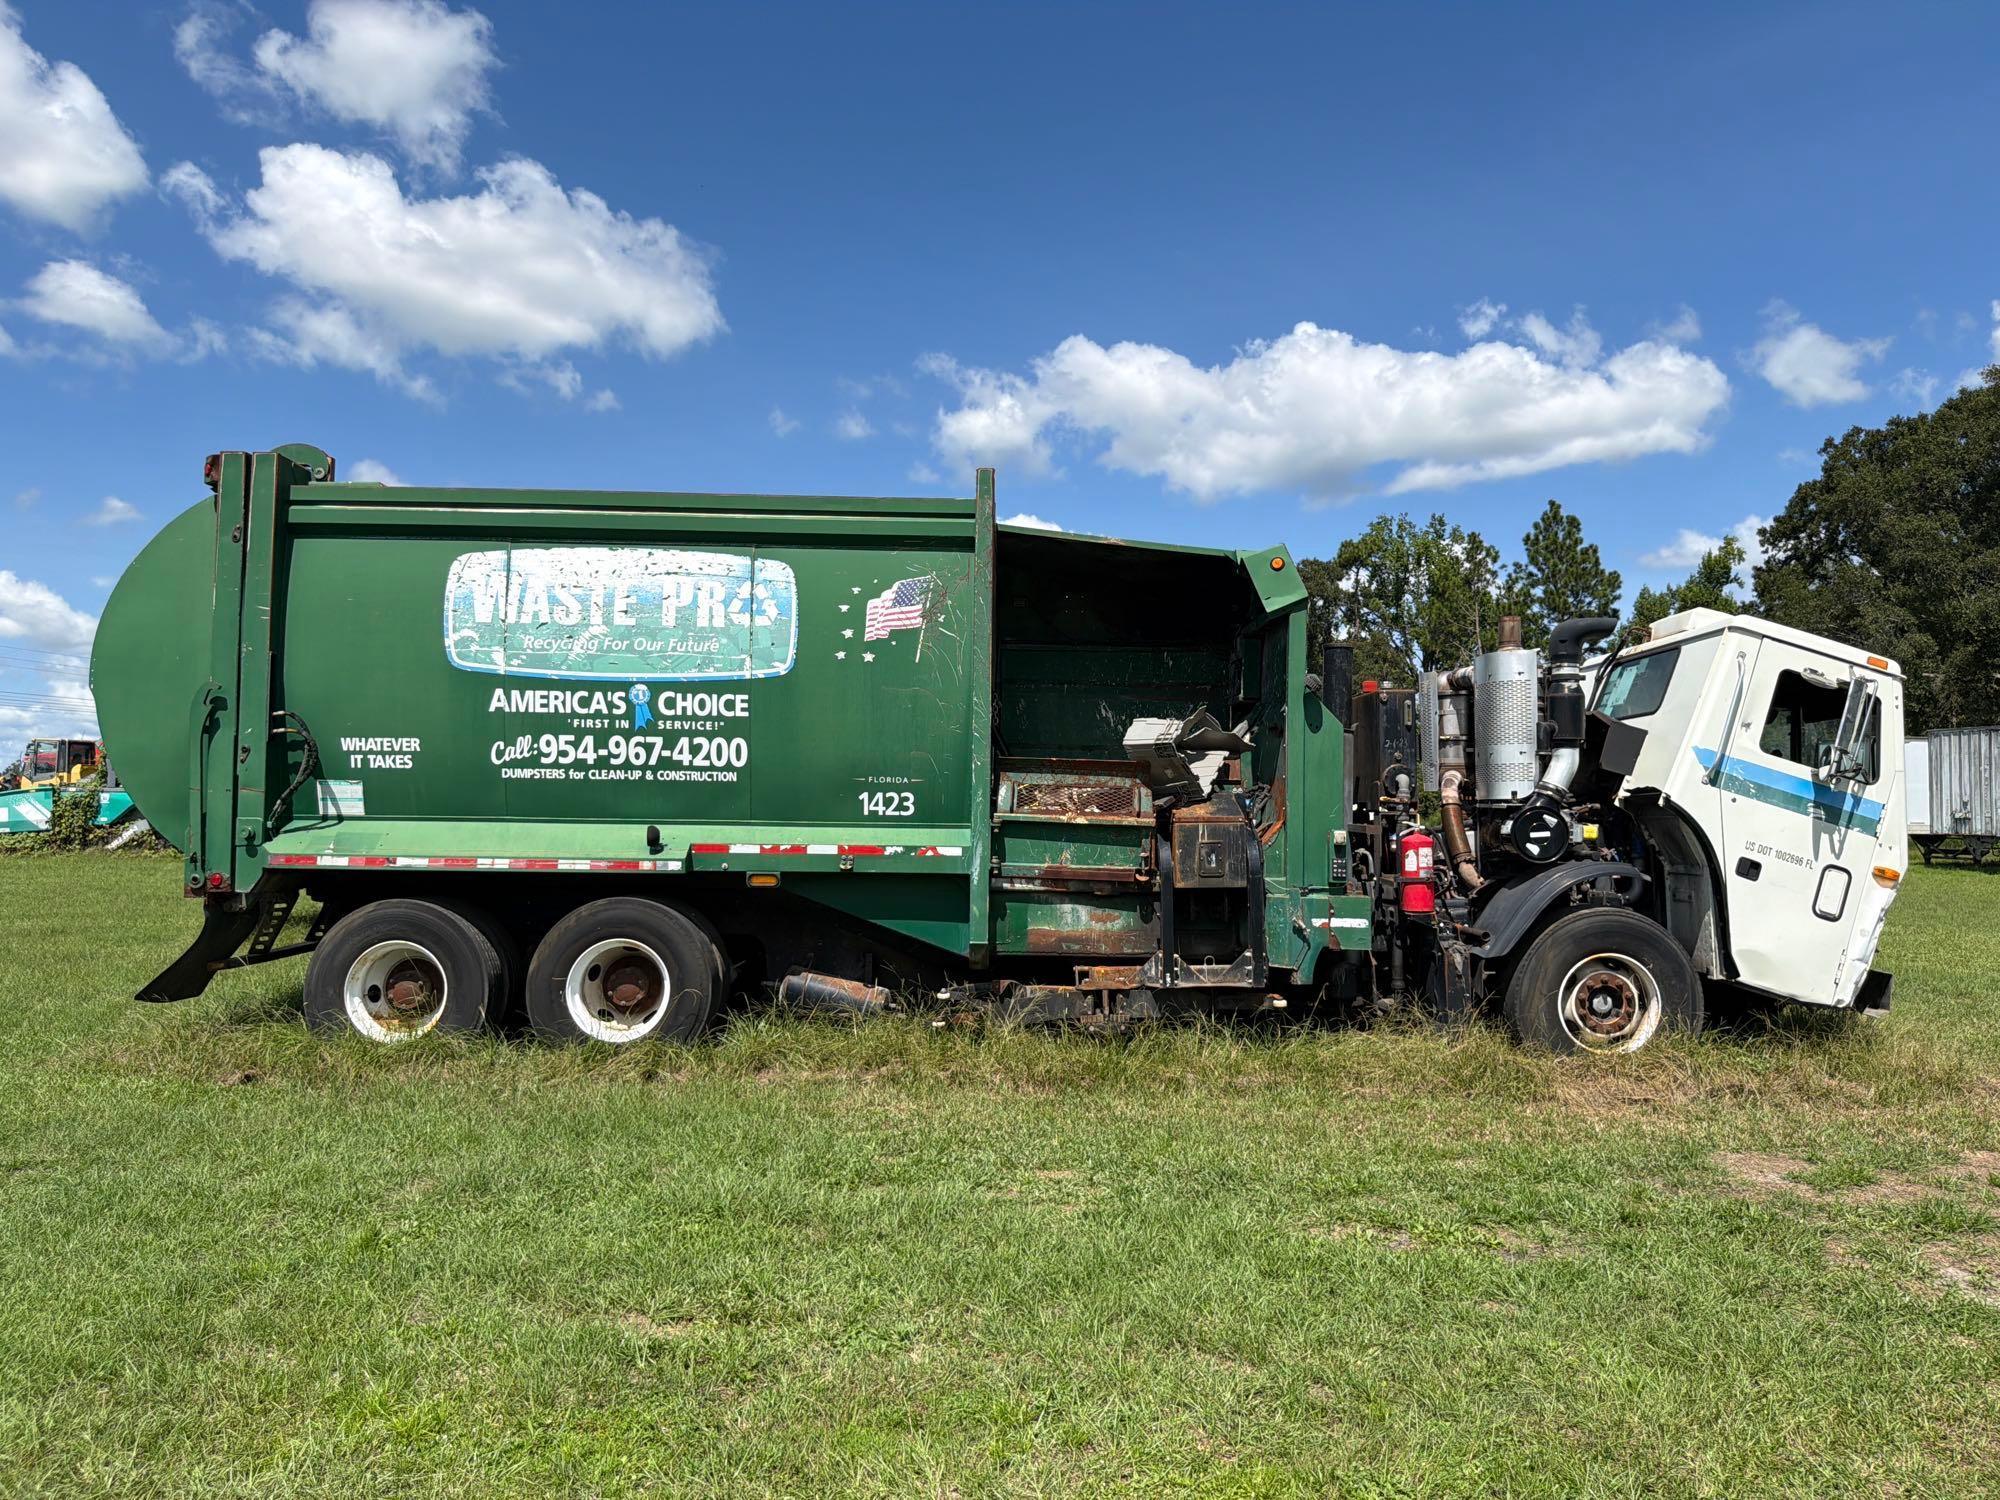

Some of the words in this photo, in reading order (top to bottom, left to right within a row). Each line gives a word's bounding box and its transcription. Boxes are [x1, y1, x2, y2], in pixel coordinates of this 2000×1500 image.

[472, 572, 637, 626] WASTE
[603, 637, 629, 651] For
[633, 638, 664, 651] Our
[668, 638, 720, 653] Future
[488, 688, 627, 715] AMERICA'S
[657, 691, 749, 718] CHOICE
[615, 719, 630, 729] IN
[340, 737, 421, 752] WHATEVER
[539, 733, 749, 768] 954-967-4200
[350, 754, 363, 769] IT
[367, 754, 413, 769] TAKES
[501, 768, 566, 780] DUMPSTERS
[568, 769, 585, 780] for
[588, 769, 642, 781] CLEAN-UP
[645, 770, 654, 781] &
[656, 770, 738, 782] CONSTRUCTION
[868, 776, 908, 784] FLORIDA
[858, 791, 915, 816] 1423
[1745, 840, 1756, 852] US
[1757, 844, 1773, 857] DOT
[1775, 849, 1804, 866] 1002696
[1805, 858, 1814, 870] FL
